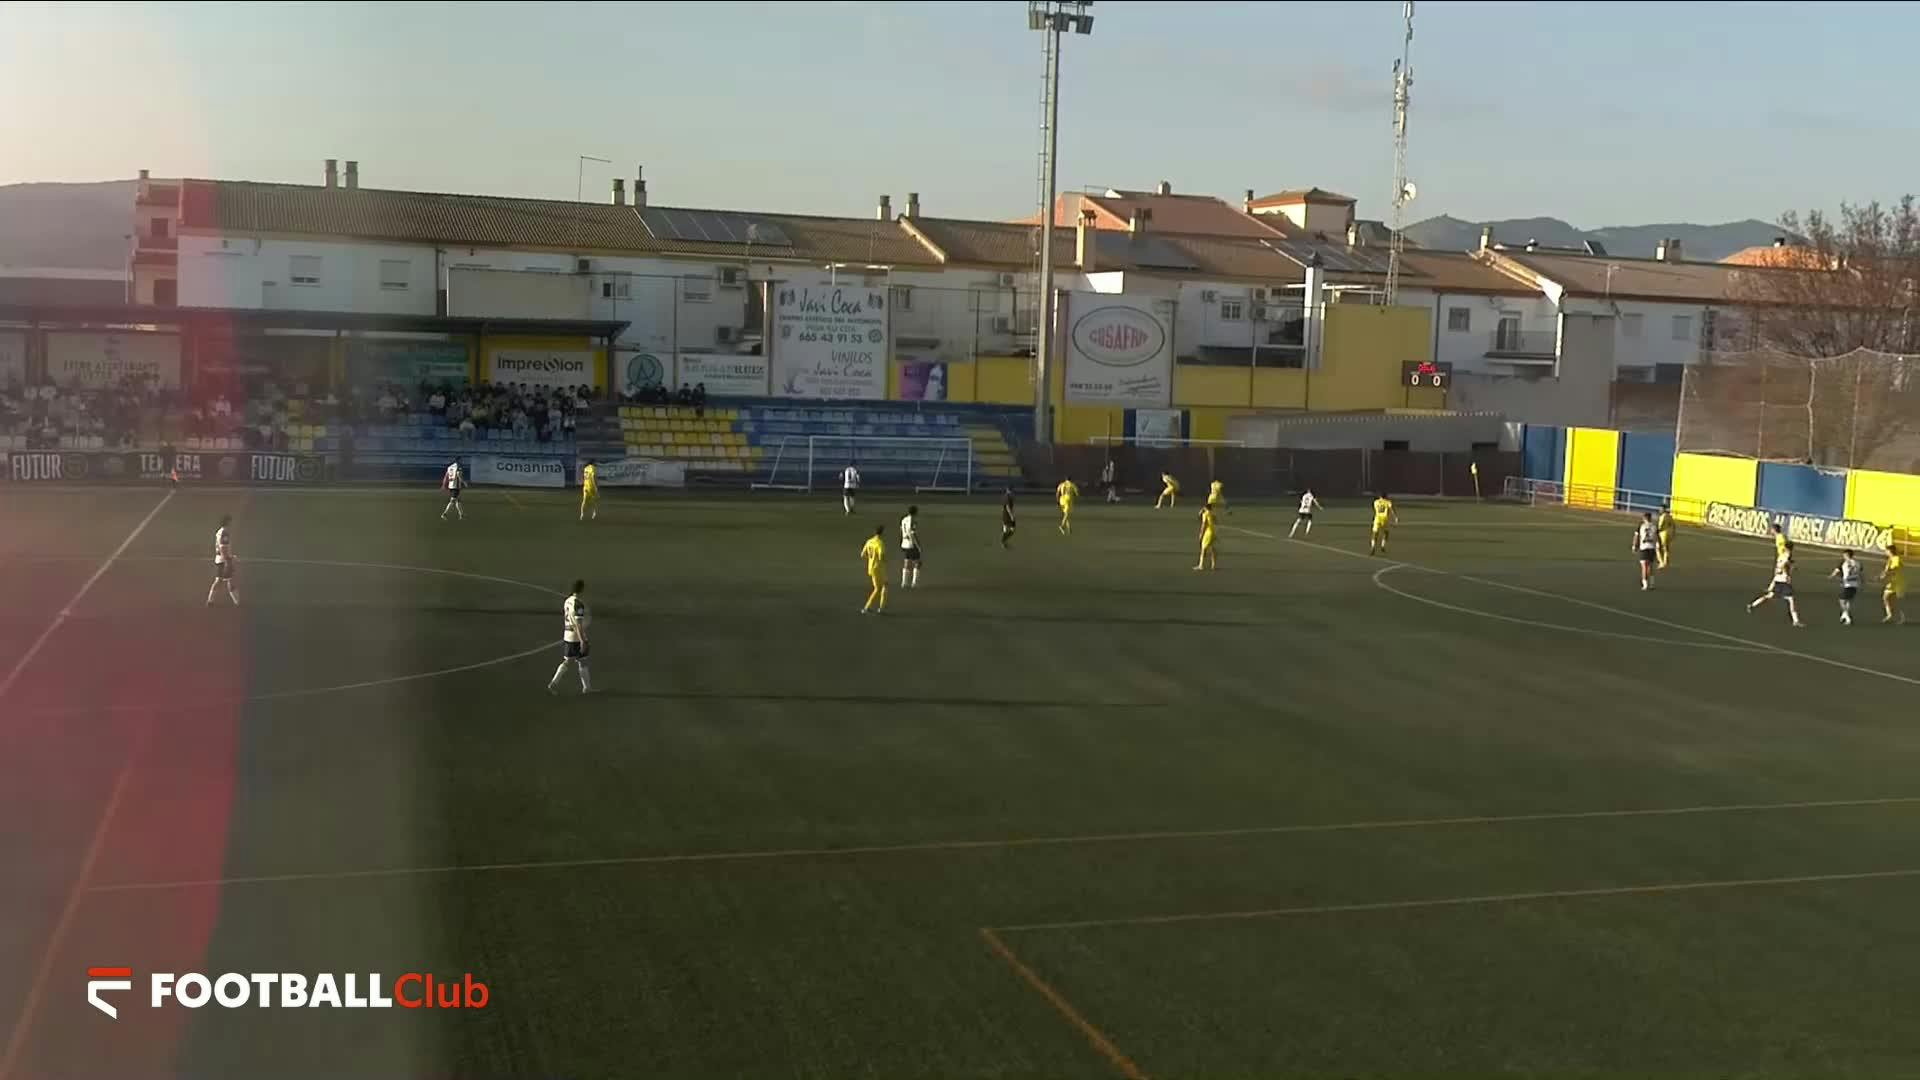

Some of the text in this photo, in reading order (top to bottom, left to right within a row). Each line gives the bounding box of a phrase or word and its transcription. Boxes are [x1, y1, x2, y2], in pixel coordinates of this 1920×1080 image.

[831, 289, 862, 314] Coca
[1411, 375, 1441, 386] 0 0
[1788, 516, 1826, 543] MIGUEL
